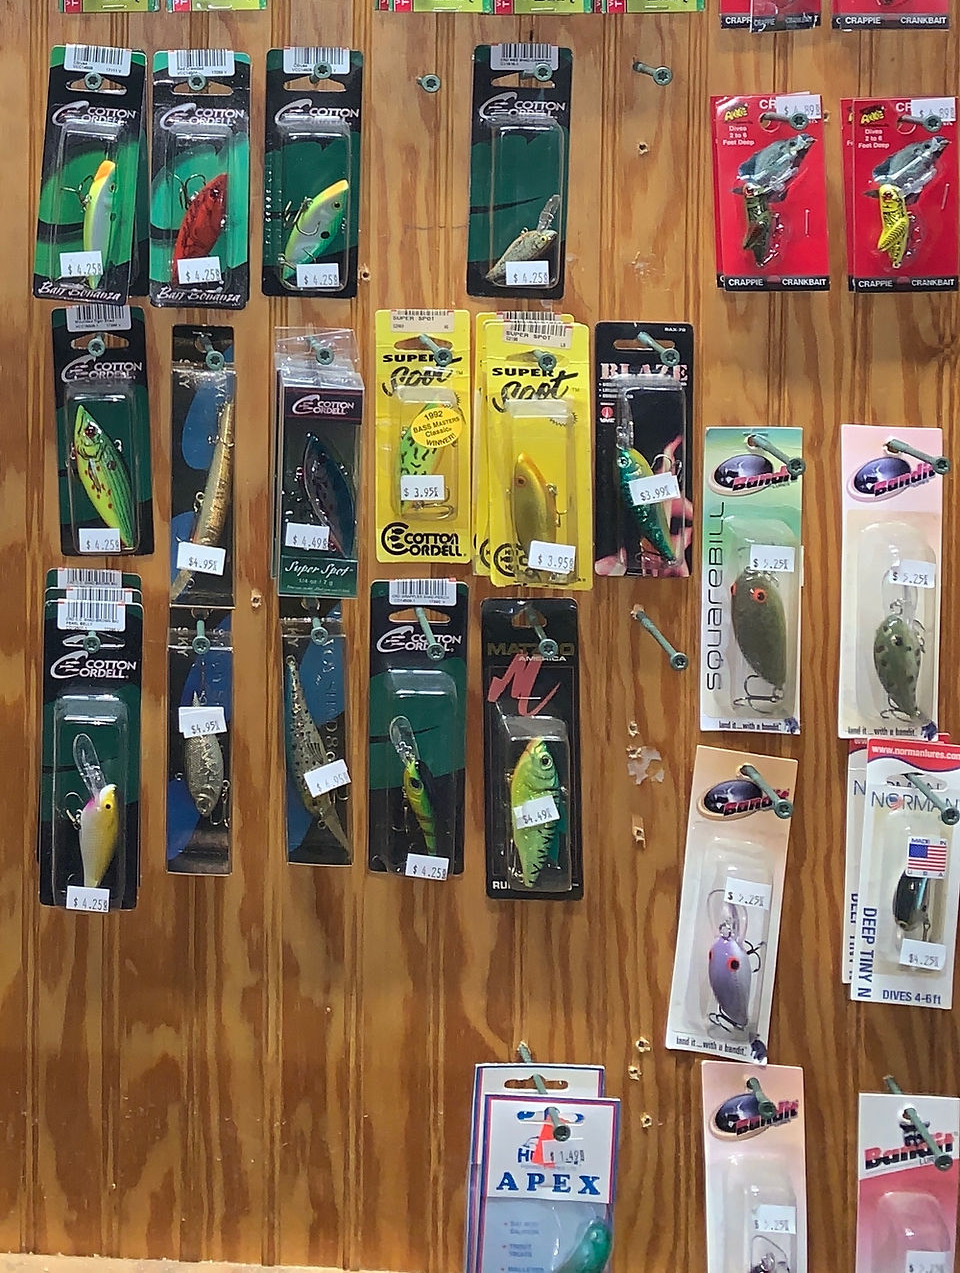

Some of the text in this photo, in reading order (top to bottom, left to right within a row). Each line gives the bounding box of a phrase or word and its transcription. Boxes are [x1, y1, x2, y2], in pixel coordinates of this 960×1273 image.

[845, 16, 947, 25] CRAPPIE CRANKBAIT
[512, 100, 565, 111] COTTON
[87, 107, 136, 120] COTTON
[492, 367, 555, 378] SUPER
[600, 363, 687, 380] BLAZE
[403, 534, 459, 545] COTTON
[518, 654, 567, 662] AMERICA
[85, 659, 136, 671] COTTON
[857, 907, 877, 998] DEEP TINY N
[882, 990, 912, 1002] DIVES
[496, 1171, 602, 1195] APEX
